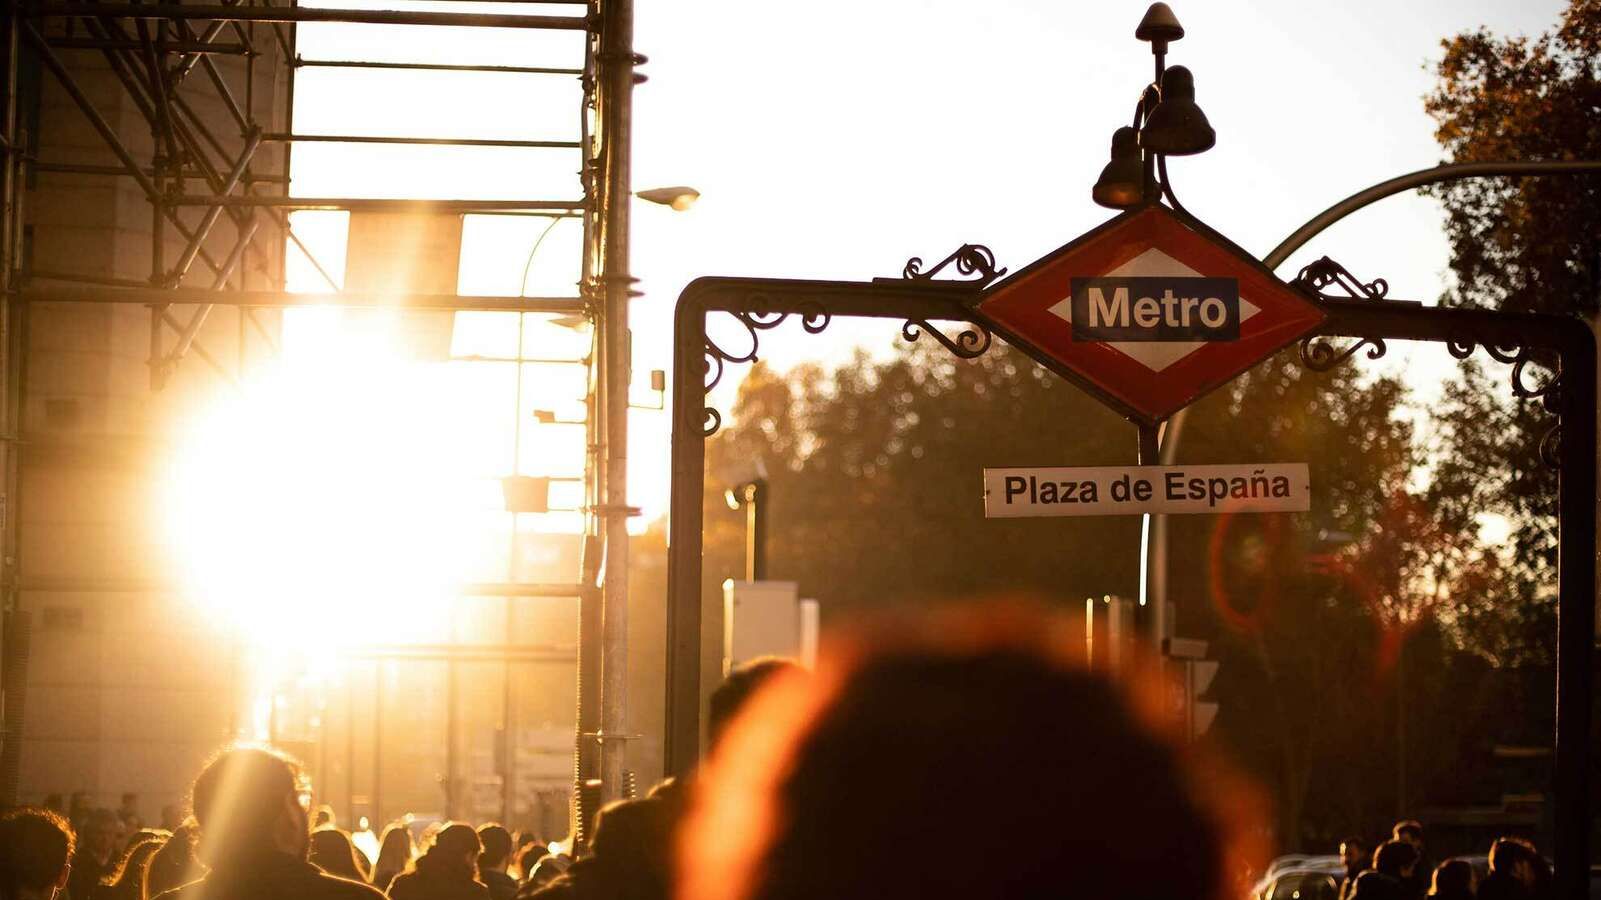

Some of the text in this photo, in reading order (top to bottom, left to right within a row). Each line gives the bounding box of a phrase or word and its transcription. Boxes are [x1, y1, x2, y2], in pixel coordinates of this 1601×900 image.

[1087, 287, 1227, 328] Metro
[1004, 469, 1290, 507] Plaza de España
